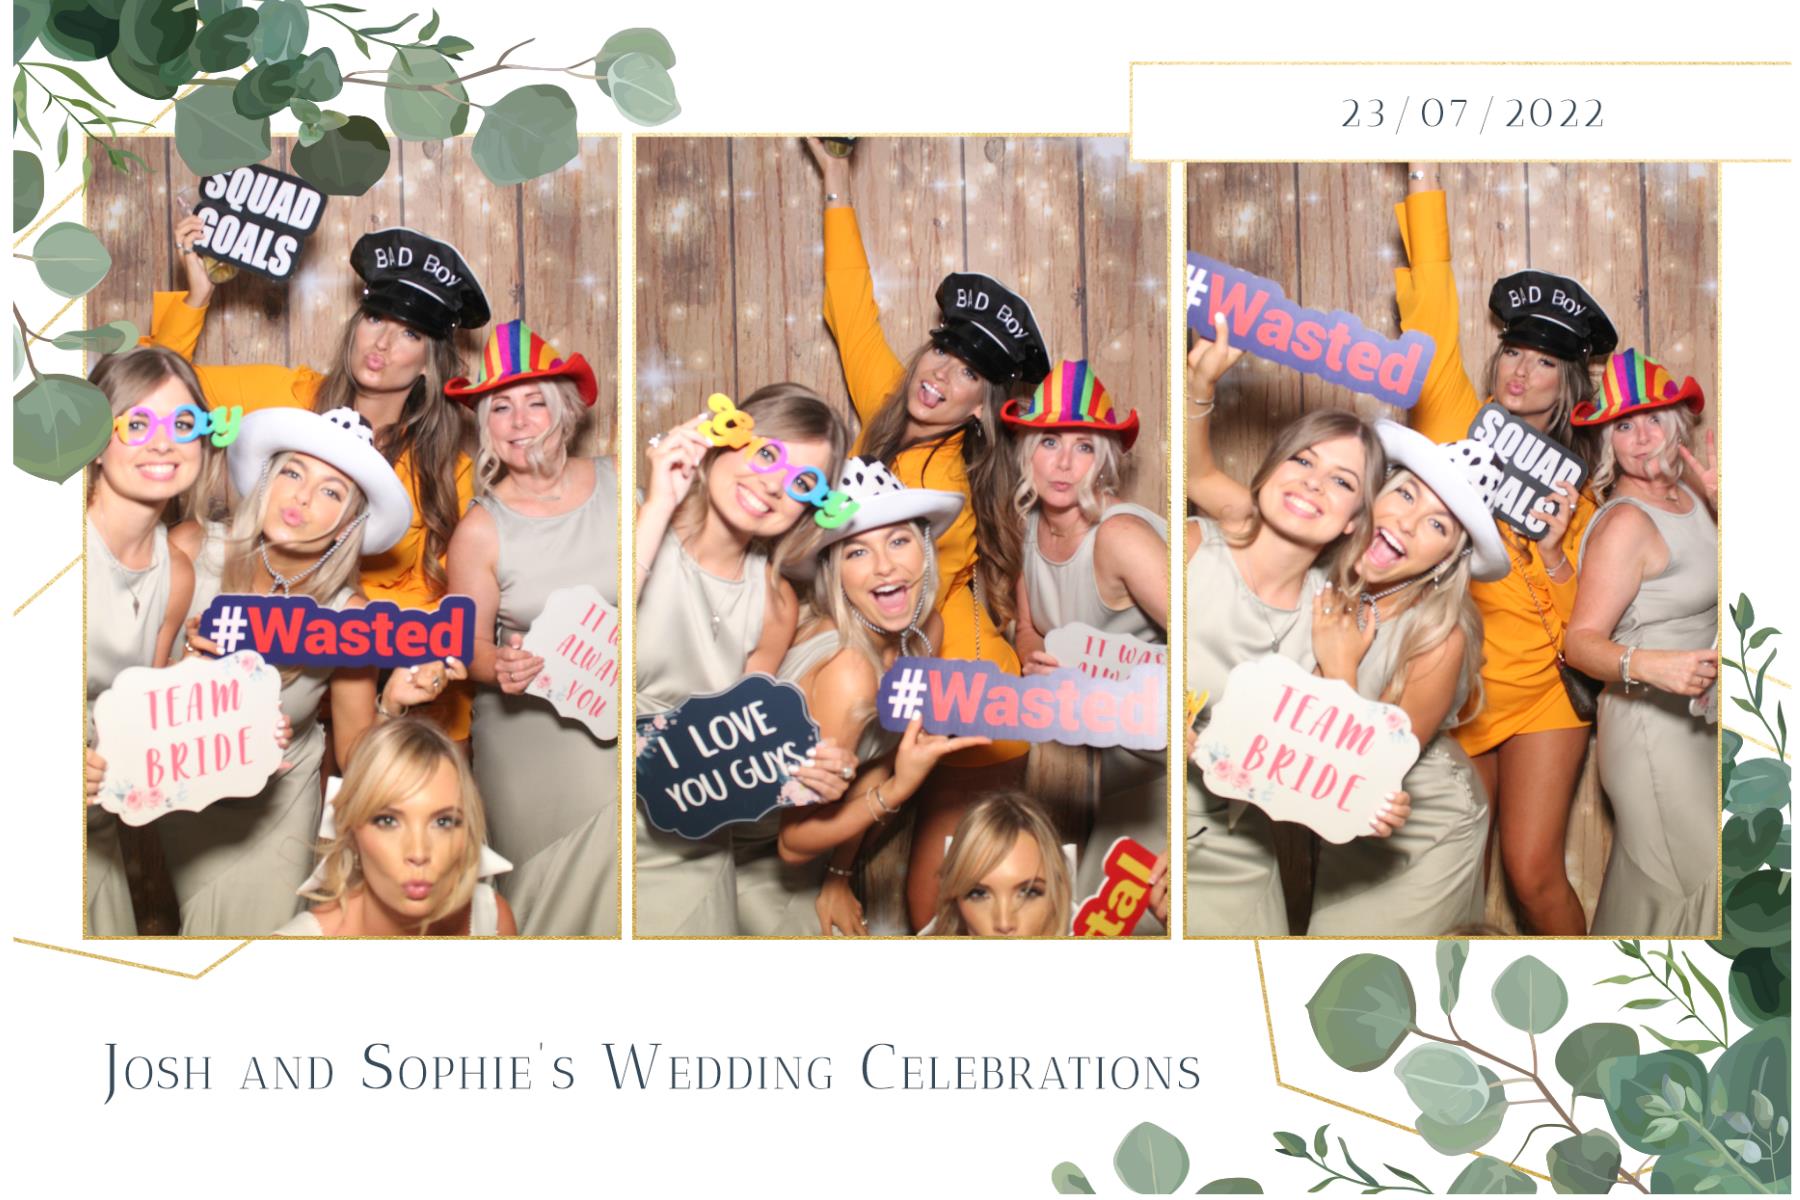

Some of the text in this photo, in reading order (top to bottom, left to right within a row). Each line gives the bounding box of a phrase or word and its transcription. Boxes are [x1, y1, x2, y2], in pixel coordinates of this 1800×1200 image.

[204, 166, 322, 231] SQUAD
[193, 206, 299, 277] GOALS
[374, 246, 462, 288] BAD BOY
[956, 288, 1029, 339] BAD BOY
[1187, 263, 1424, 396] #Wasted
[1508, 286, 1588, 317] BAD BOY
[1473, 409, 1582, 496] SQUAD
[210, 606, 465, 657] #Wasted
[580, 602, 608, 633] IT
[144, 678, 243, 731] TEAM
[566, 679, 608, 718] YOU
[888, 668, 1160, 737] #Wasted
[1272, 684, 1376, 756] TEAM
[146, 725, 255, 789] BRIDE
[656, 700, 778, 769] I LOVE
[664, 741, 807, 812] YOU GUYS
[1242, 734, 1368, 812] BRIDE
